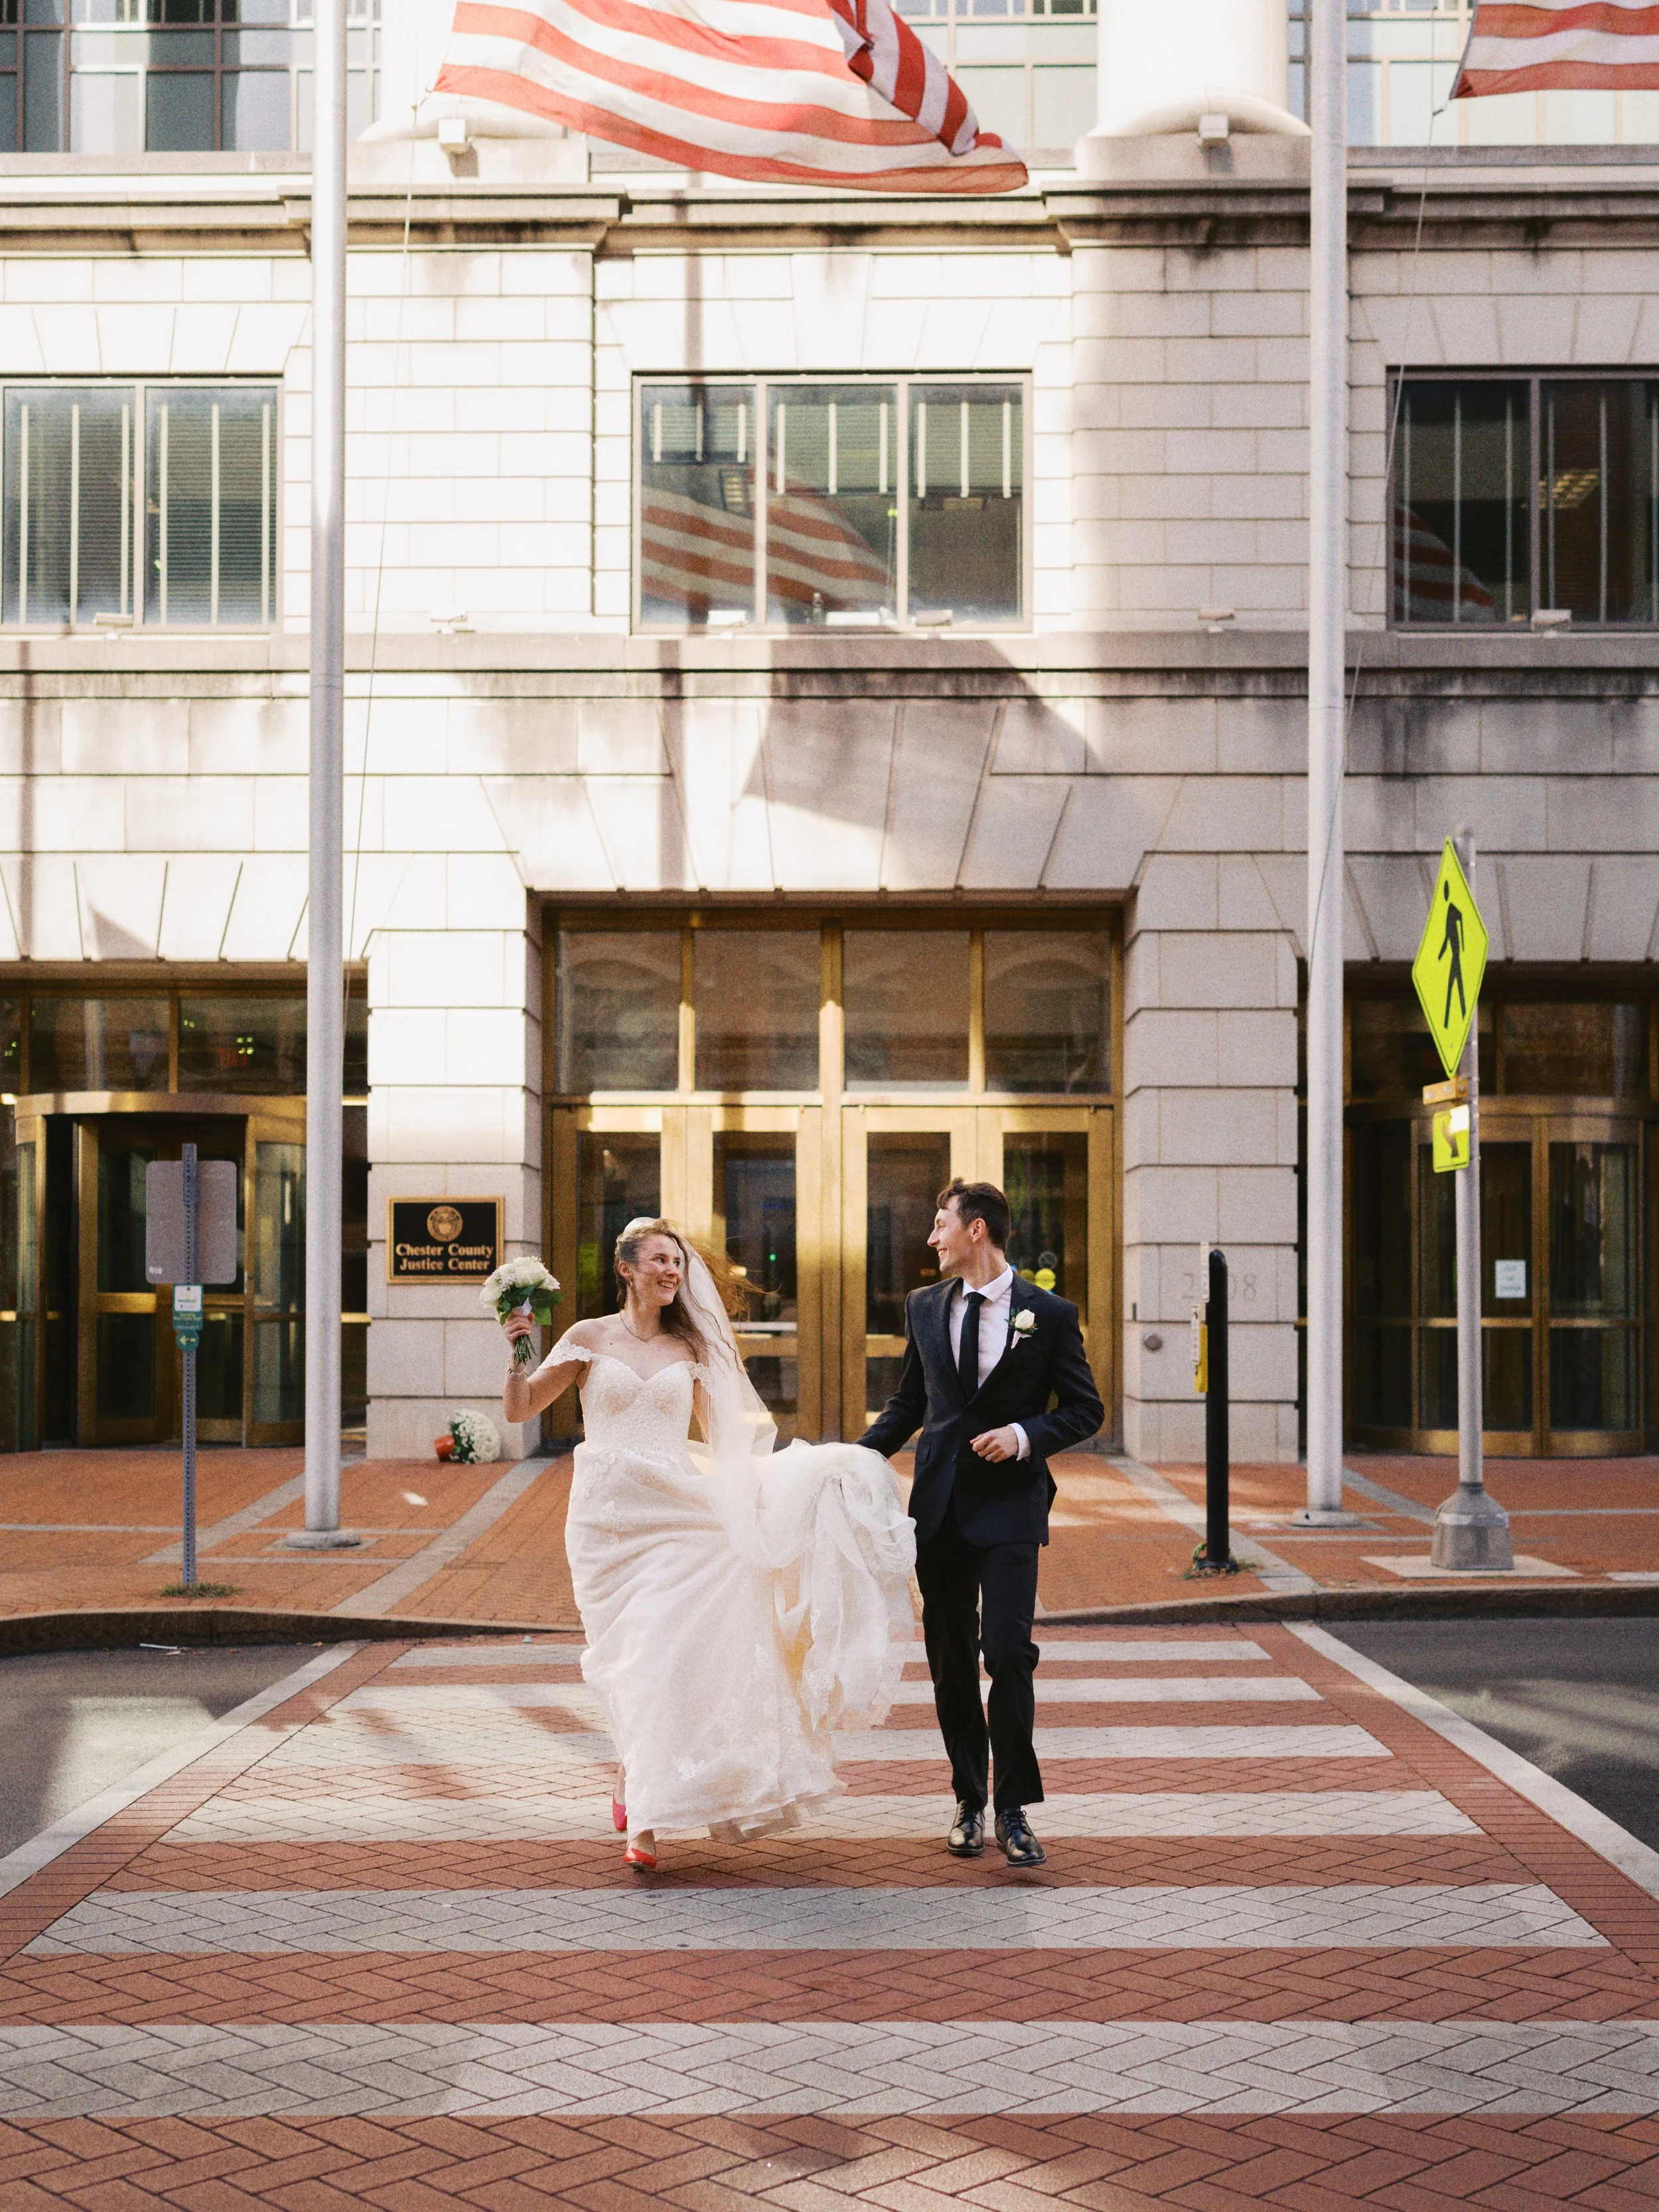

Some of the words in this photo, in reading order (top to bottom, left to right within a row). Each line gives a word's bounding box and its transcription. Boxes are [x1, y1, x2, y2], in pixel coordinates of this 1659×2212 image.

[396, 1243, 444, 1256] Chester
[448, 1243, 493, 1258] County
[400, 1258, 443, 1270] Justice
[448, 1258, 490, 1270] Center
